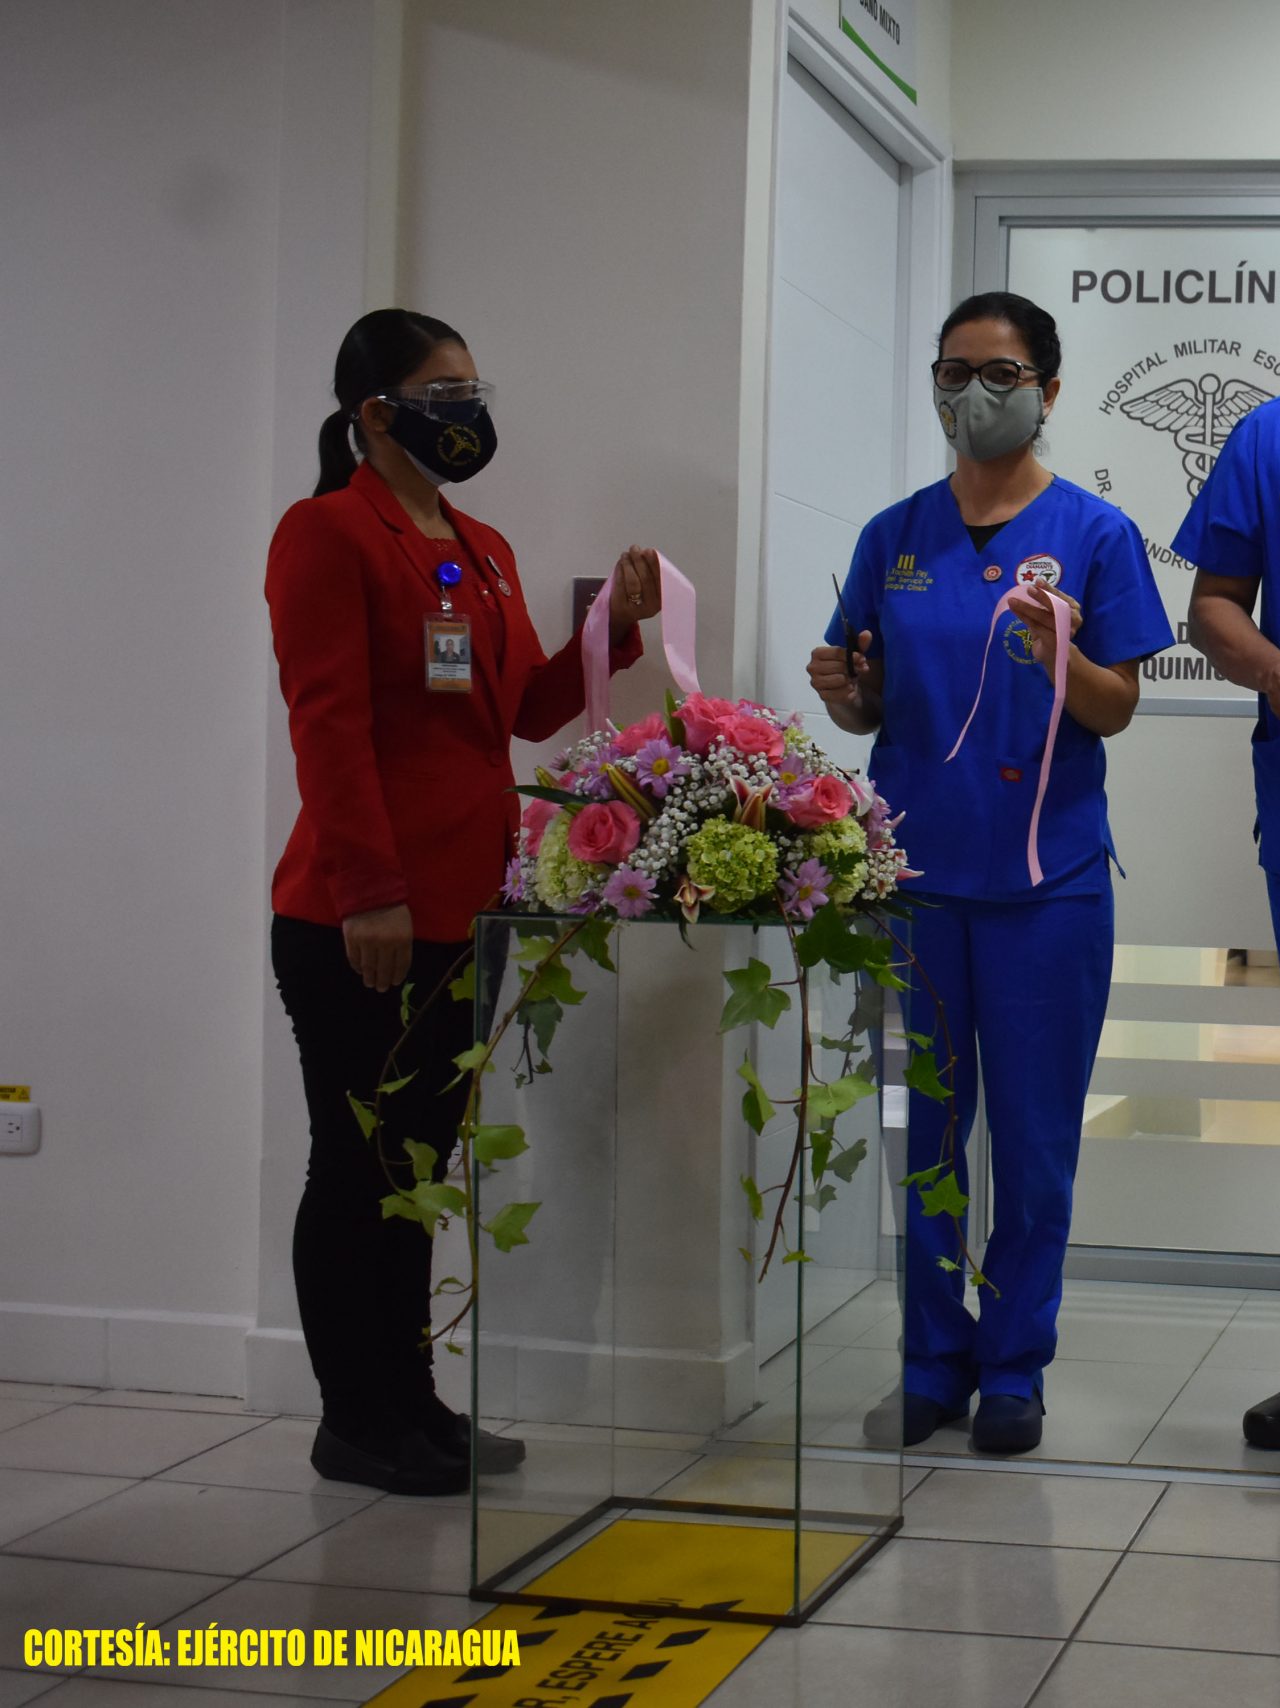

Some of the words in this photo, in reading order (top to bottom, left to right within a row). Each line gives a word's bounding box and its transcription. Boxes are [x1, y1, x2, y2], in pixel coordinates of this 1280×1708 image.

[880, 5, 900, 45] MIXTO
[1098, 352, 1168, 415] HOSPITAL
[1173, 339, 1242, 358] MILITAR
[1142, 656, 1228, 682] QUIMI
[536, 1630, 644, 1691] ESPERE
